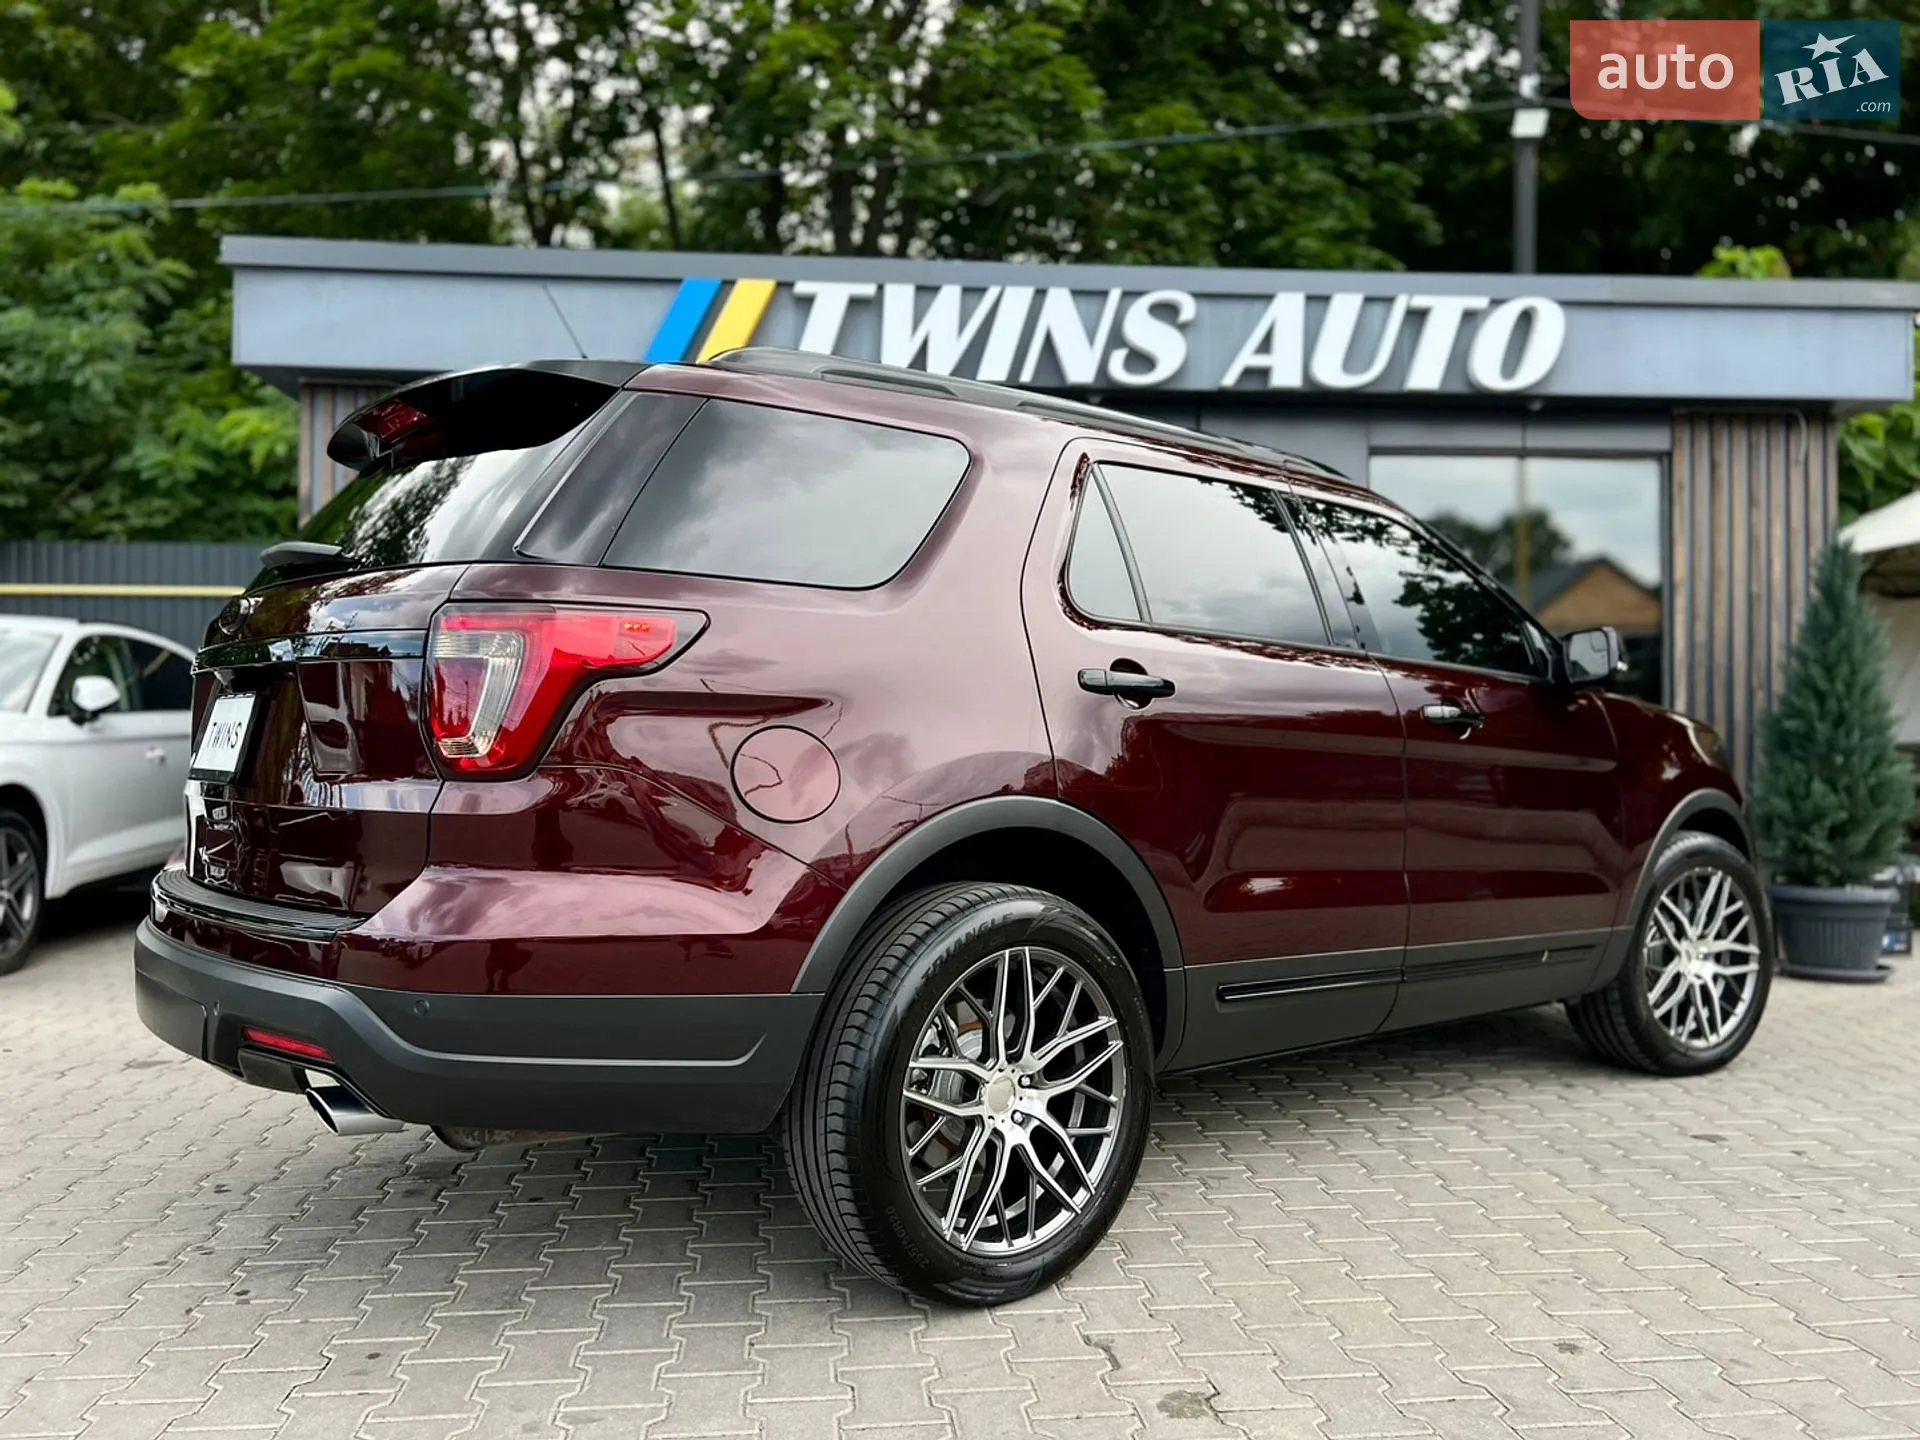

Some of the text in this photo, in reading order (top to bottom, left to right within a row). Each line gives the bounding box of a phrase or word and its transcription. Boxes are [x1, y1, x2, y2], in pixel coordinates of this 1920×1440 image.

[792, 281, 1566, 393] TWINS AUTO
[206, 721, 242, 749] TWINS
[919, 912, 1016, 984] TRIANGLE
